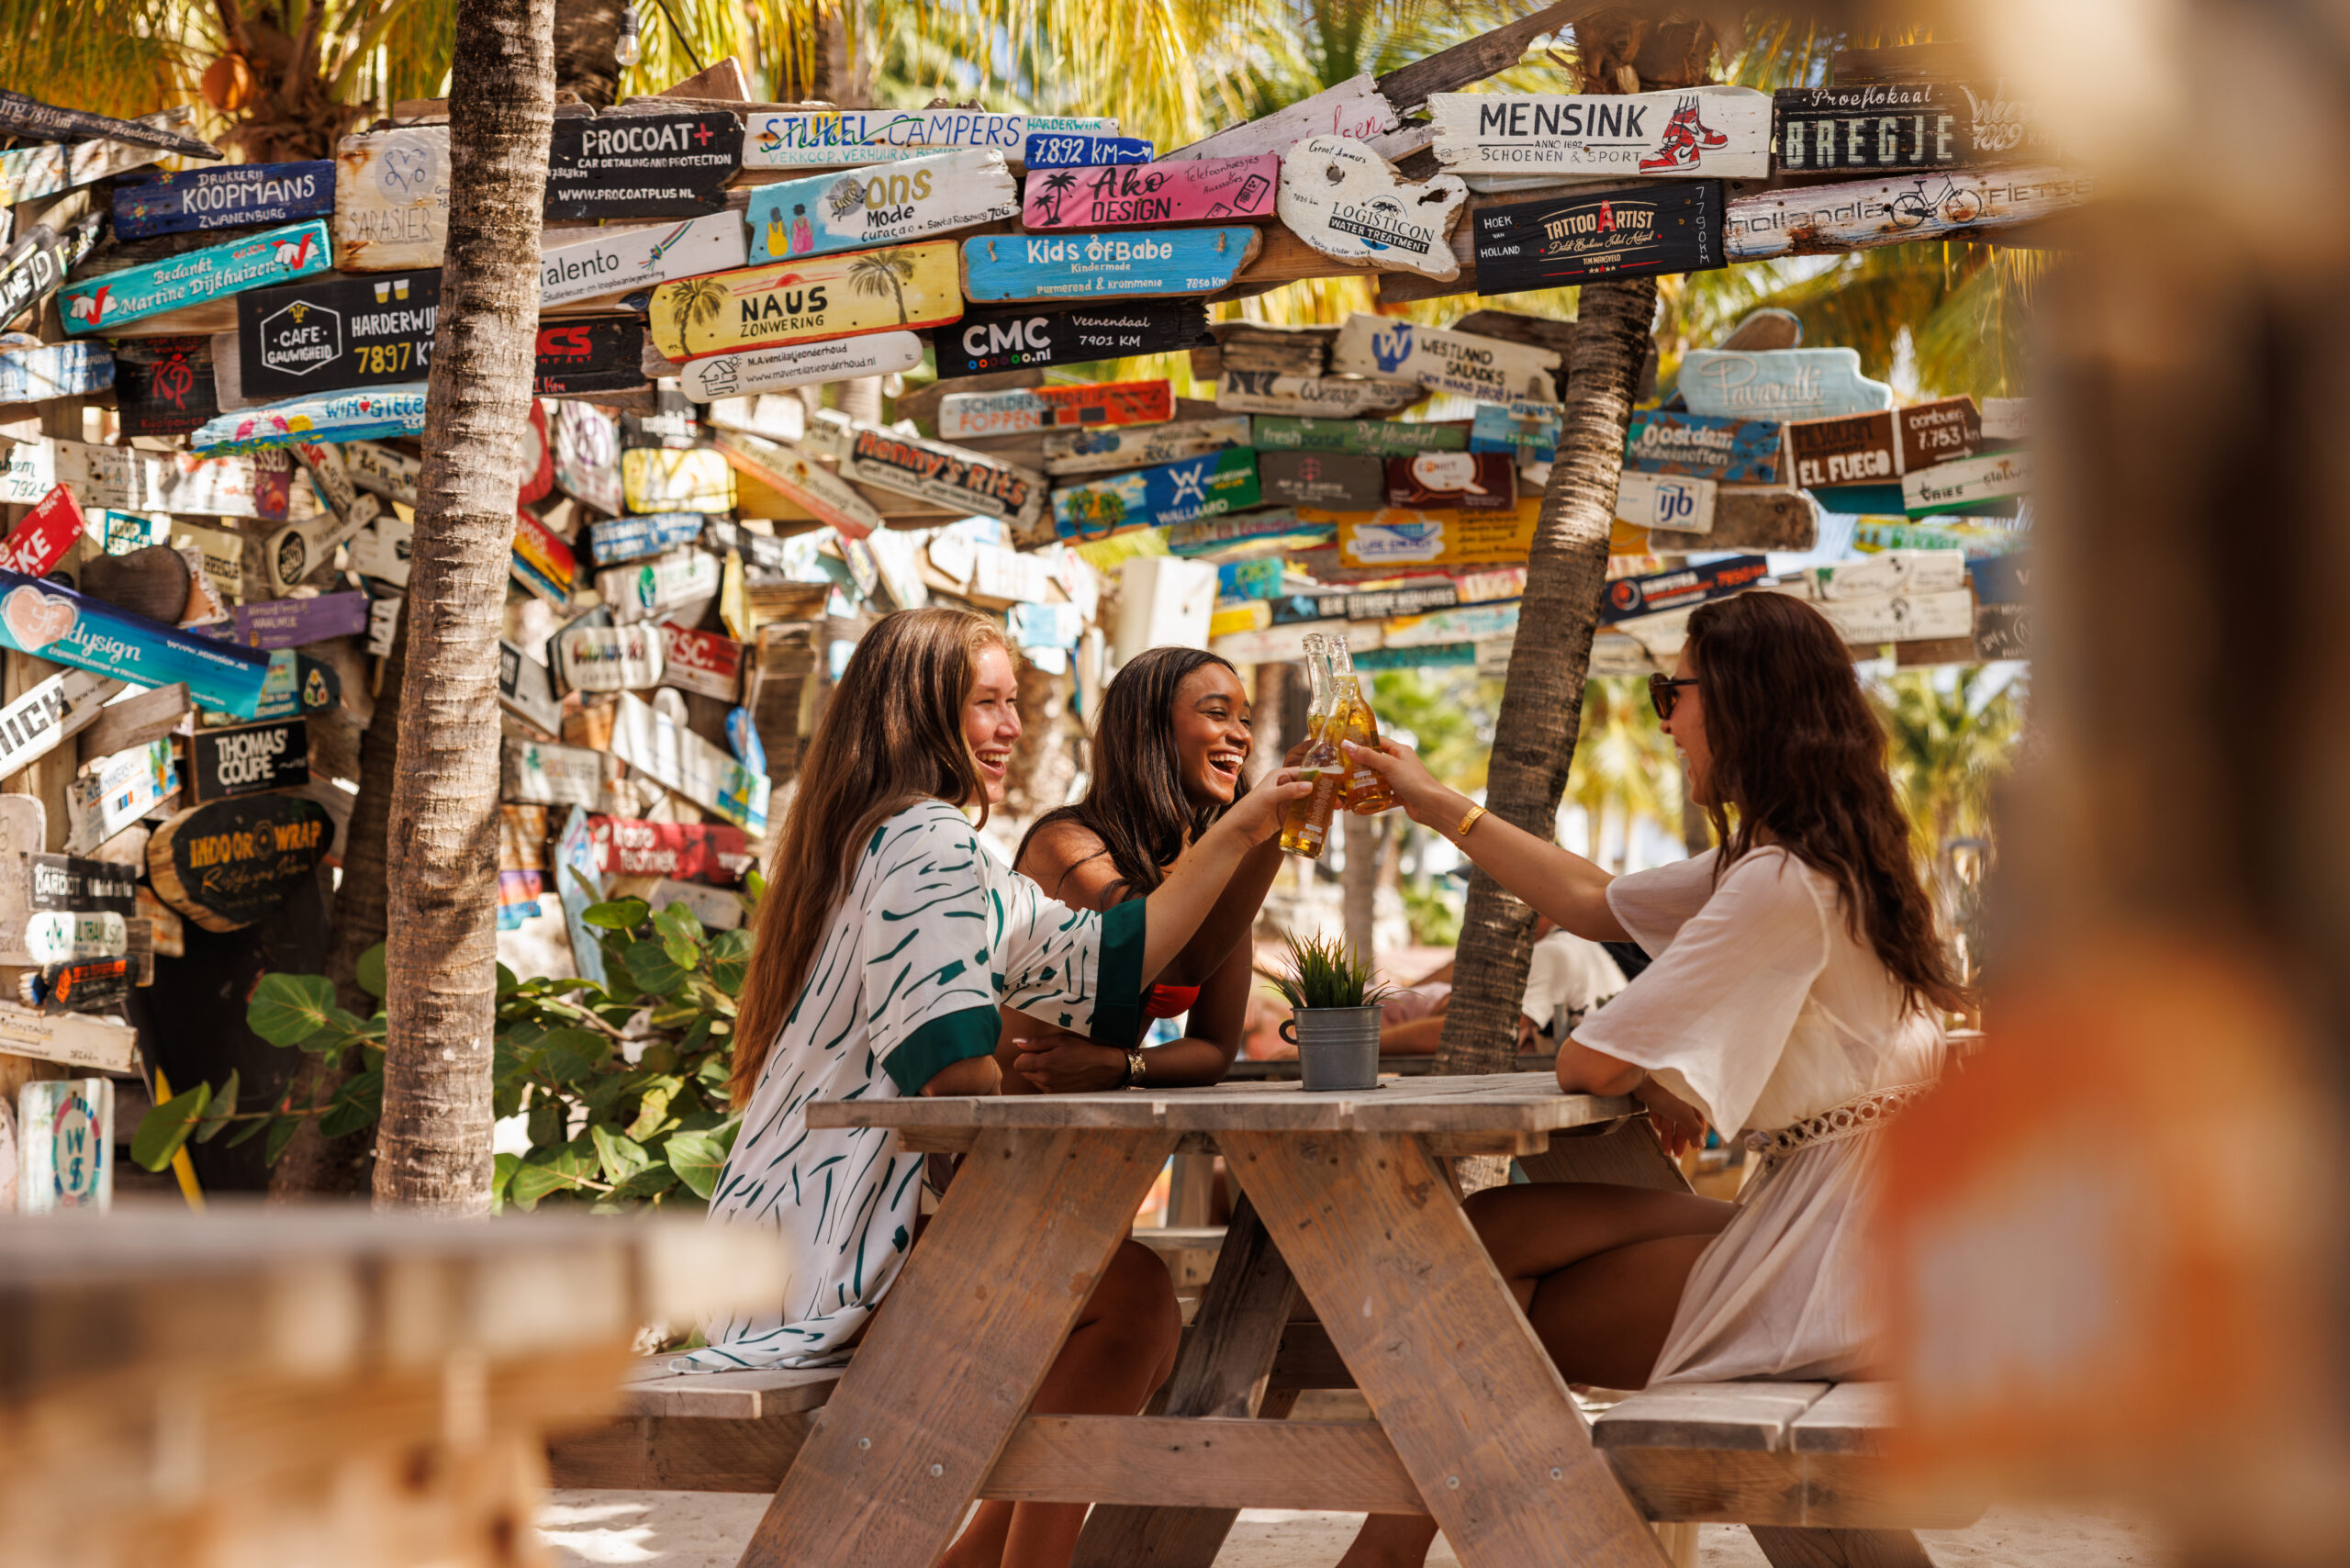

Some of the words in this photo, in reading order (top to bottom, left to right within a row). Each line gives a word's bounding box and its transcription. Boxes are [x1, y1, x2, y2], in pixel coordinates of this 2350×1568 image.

[1811, 85, 1932, 109] Proeflokaal
[888, 114, 1022, 148] CAMPERS
[1027, 118, 1103, 131] HARDERWIJK
[1480, 103, 1648, 138] MENSINK
[843, 147, 898, 162] VERHUUR
[1035, 138, 1085, 163] 7.892
[1481, 148, 1563, 162] SCHOENEN
[1571, 152, 1581, 162] &
[1586, 151, 1642, 163] SPORT
[1534, 140, 1561, 149] ANNO
[577, 158, 599, 169] CAR
[600, 157, 650, 169] DETAILING
[668, 153, 732, 168] PROTECTION
[183, 174, 316, 214] KOOPMANS
[864, 169, 934, 210] ons
[198, 207, 286, 229] ZWANENBURG
[1091, 196, 1171, 223] DESIGN
[1332, 202, 1435, 242] LOGISTICON
[1483, 215, 1513, 230] HOEK
[1544, 213, 1597, 241] TATTOO
[1597, 199, 1655, 234] ARTIST
[1330, 218, 1365, 235] WATER
[1366, 228, 1429, 254] TREATMENT
[1026, 239, 1080, 263] Kids
[1480, 245, 1521, 259] HOLLAND
[153, 257, 213, 286] Bedankt
[119, 285, 185, 315] Martine
[189, 260, 277, 297] Dijkhuizen
[742, 286, 828, 323] NAUS
[352, 304, 441, 338] HARDERWIJ
[740, 314, 825, 339] ZONWERING
[1071, 314, 1151, 328] Veenendaal
[279, 326, 321, 348] CAFE
[963, 317, 1052, 357] CMC
[1079, 334, 1114, 347] 7901
[1119, 334, 1141, 348] KM
[267, 343, 333, 364] GAUWIGHEID
[353, 342, 412, 375] 7897
[1420, 337, 1494, 364] WESTLAND
[1445, 361, 1505, 386] SALADES
[959, 409, 1042, 431] FOPPEN
[856, 429, 965, 485] Henny's
[966, 463, 1027, 506] Rits
[1799, 459, 1826, 487] EL
[1828, 449, 1891, 483] FUEGO
[0, 685, 73, 758] ICK
